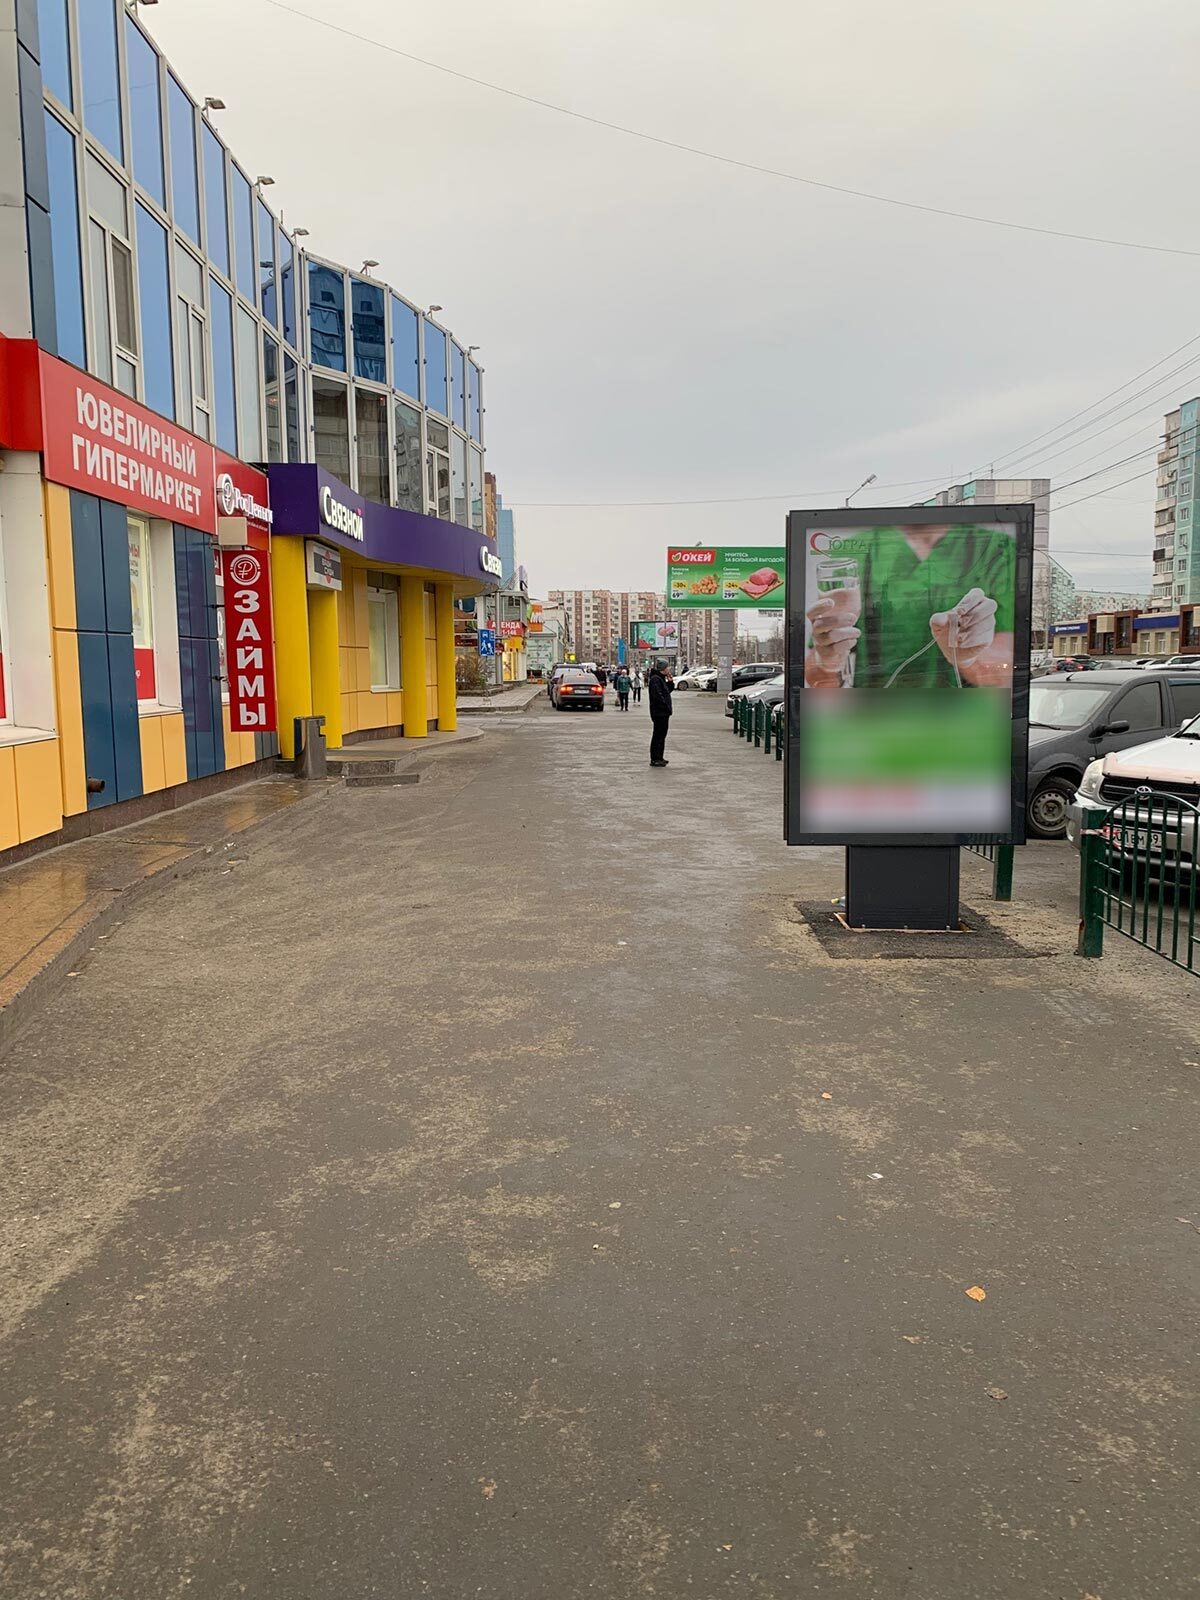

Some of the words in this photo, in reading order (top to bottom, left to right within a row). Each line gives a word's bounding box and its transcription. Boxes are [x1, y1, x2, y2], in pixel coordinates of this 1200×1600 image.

[76, 387, 197, 478] ЮВЕЛИРНЫЙ
[72, 433, 201, 515] ГИПЕРМАРКЕТ
[828, 539, 866, 551] ЮГРА
[233, 589, 268, 727] ЗАЙМЫ
[491, 621, 521, 629] АЕНДА
